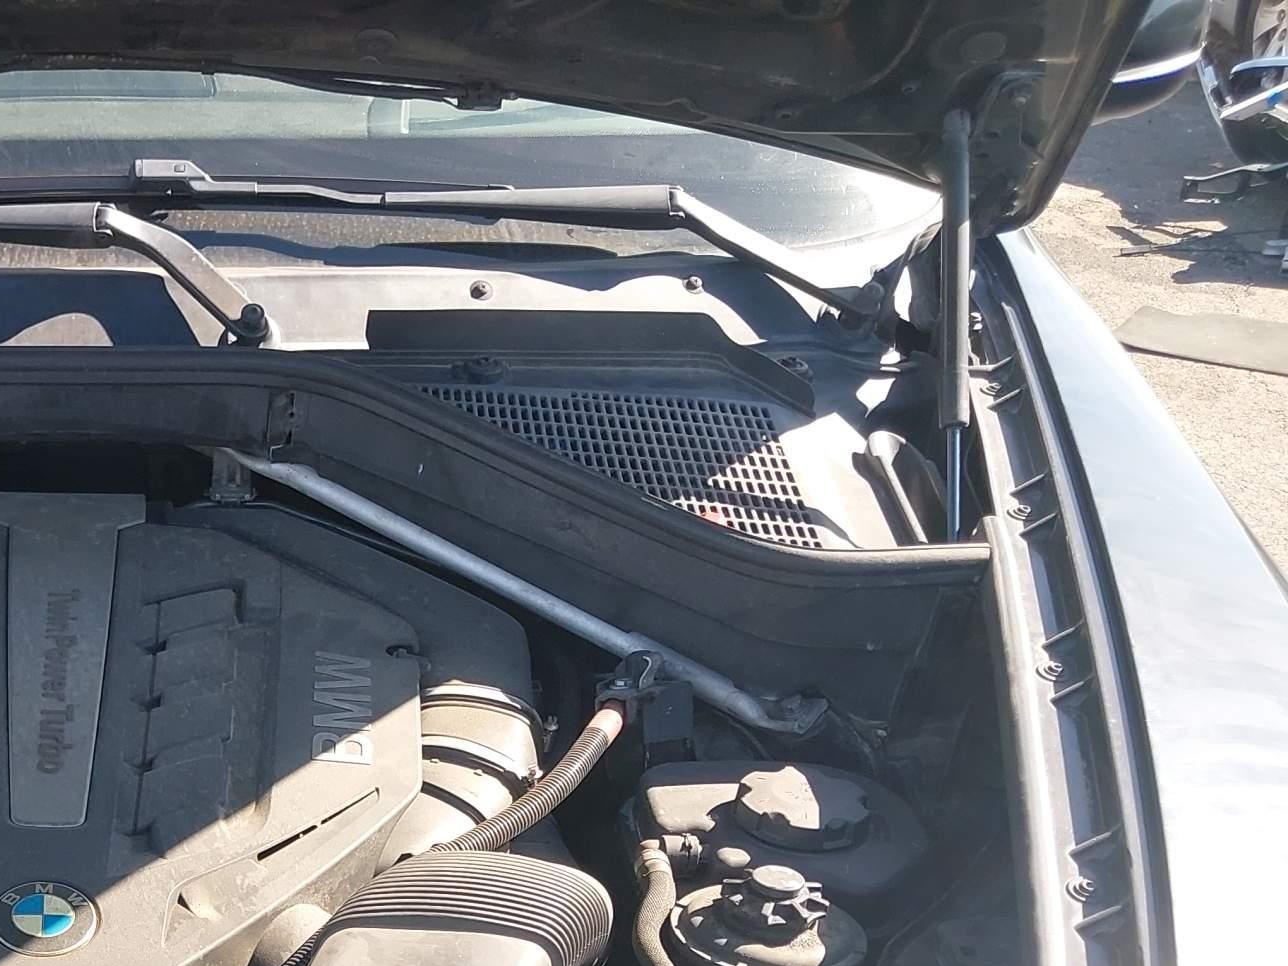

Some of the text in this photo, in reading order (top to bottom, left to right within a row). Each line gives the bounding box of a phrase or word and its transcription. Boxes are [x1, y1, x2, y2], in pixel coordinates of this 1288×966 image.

[36, 703, 75, 774] Turbo
[312, 650, 373, 766] BMW
[1, 883, 89, 906] BMW
